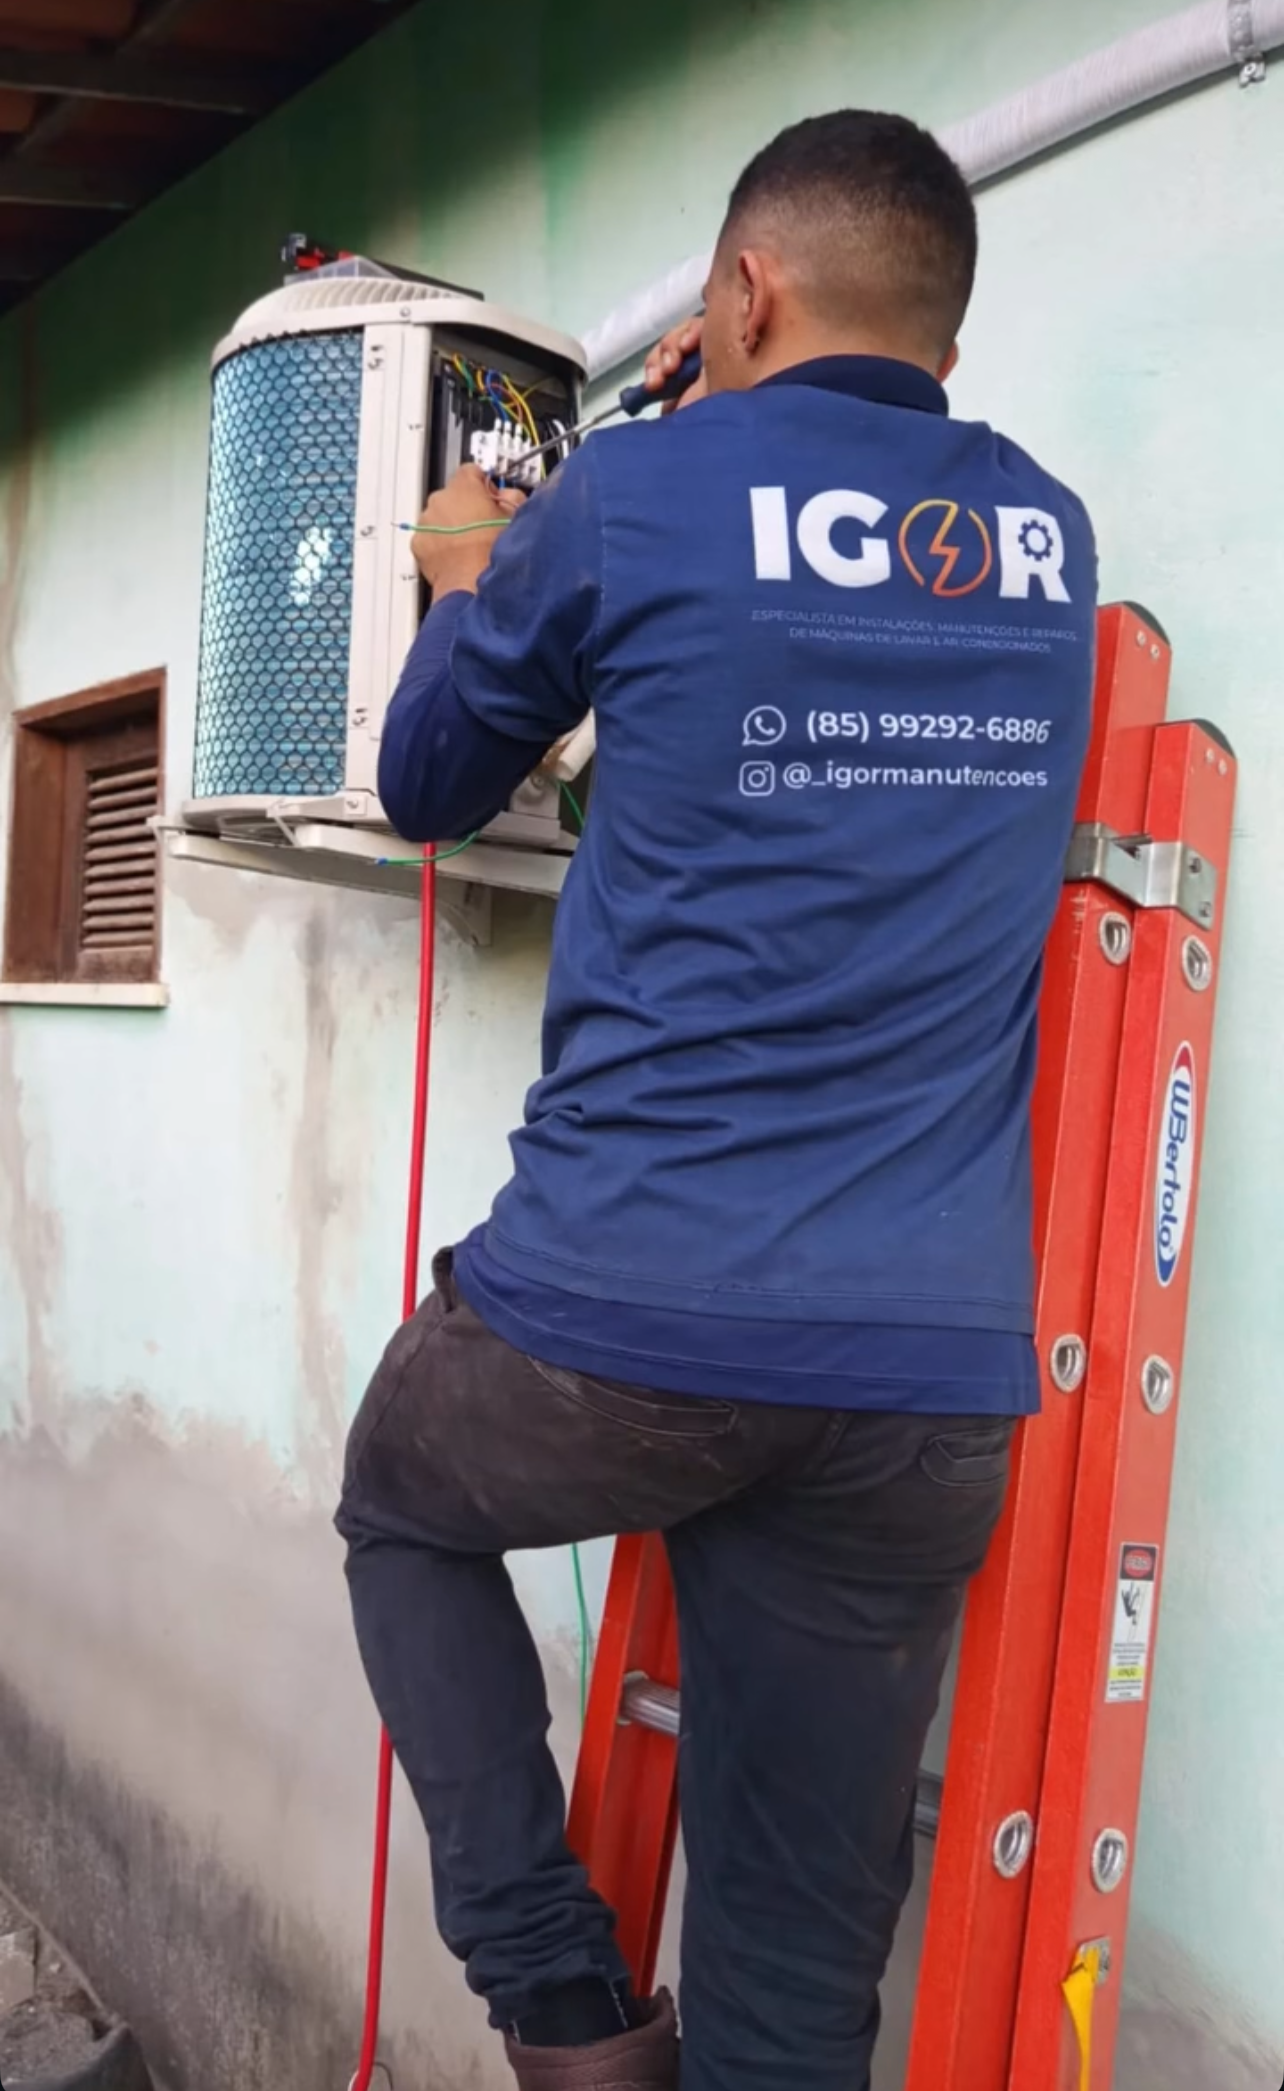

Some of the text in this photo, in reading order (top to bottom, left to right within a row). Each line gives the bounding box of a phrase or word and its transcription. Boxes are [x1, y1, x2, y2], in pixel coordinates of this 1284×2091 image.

[751, 609, 835, 625] ESPECIALISTA
[837, 613, 856, 626] EM
[789, 626, 807, 638] DE
[875, 632, 891, 644] DE
[807, 710, 1052, 744] (85) 99292-6886
[783, 761, 1048, 792] @_igormanutencoes
